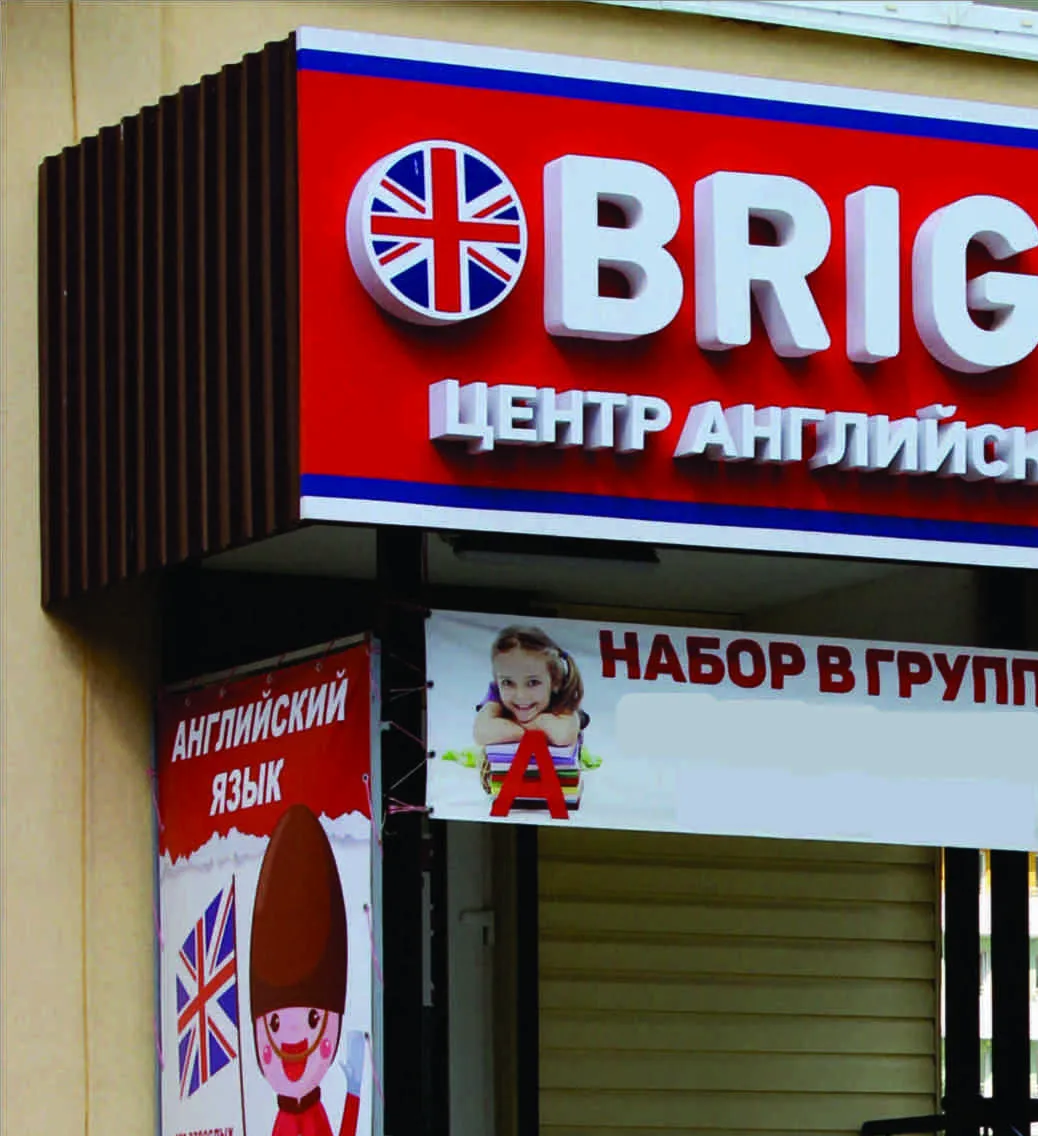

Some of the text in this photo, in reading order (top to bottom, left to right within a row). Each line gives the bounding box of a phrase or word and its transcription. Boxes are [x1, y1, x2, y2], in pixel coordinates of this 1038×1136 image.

[429, 377, 671, 454] ЦЕНТР
[599, 629, 806, 690] НАБОР
[816, 644, 857, 694] В
[171, 668, 349, 763] АНГЛИЙСКИЙ
[209, 758, 285, 817] ЯЗЫК
